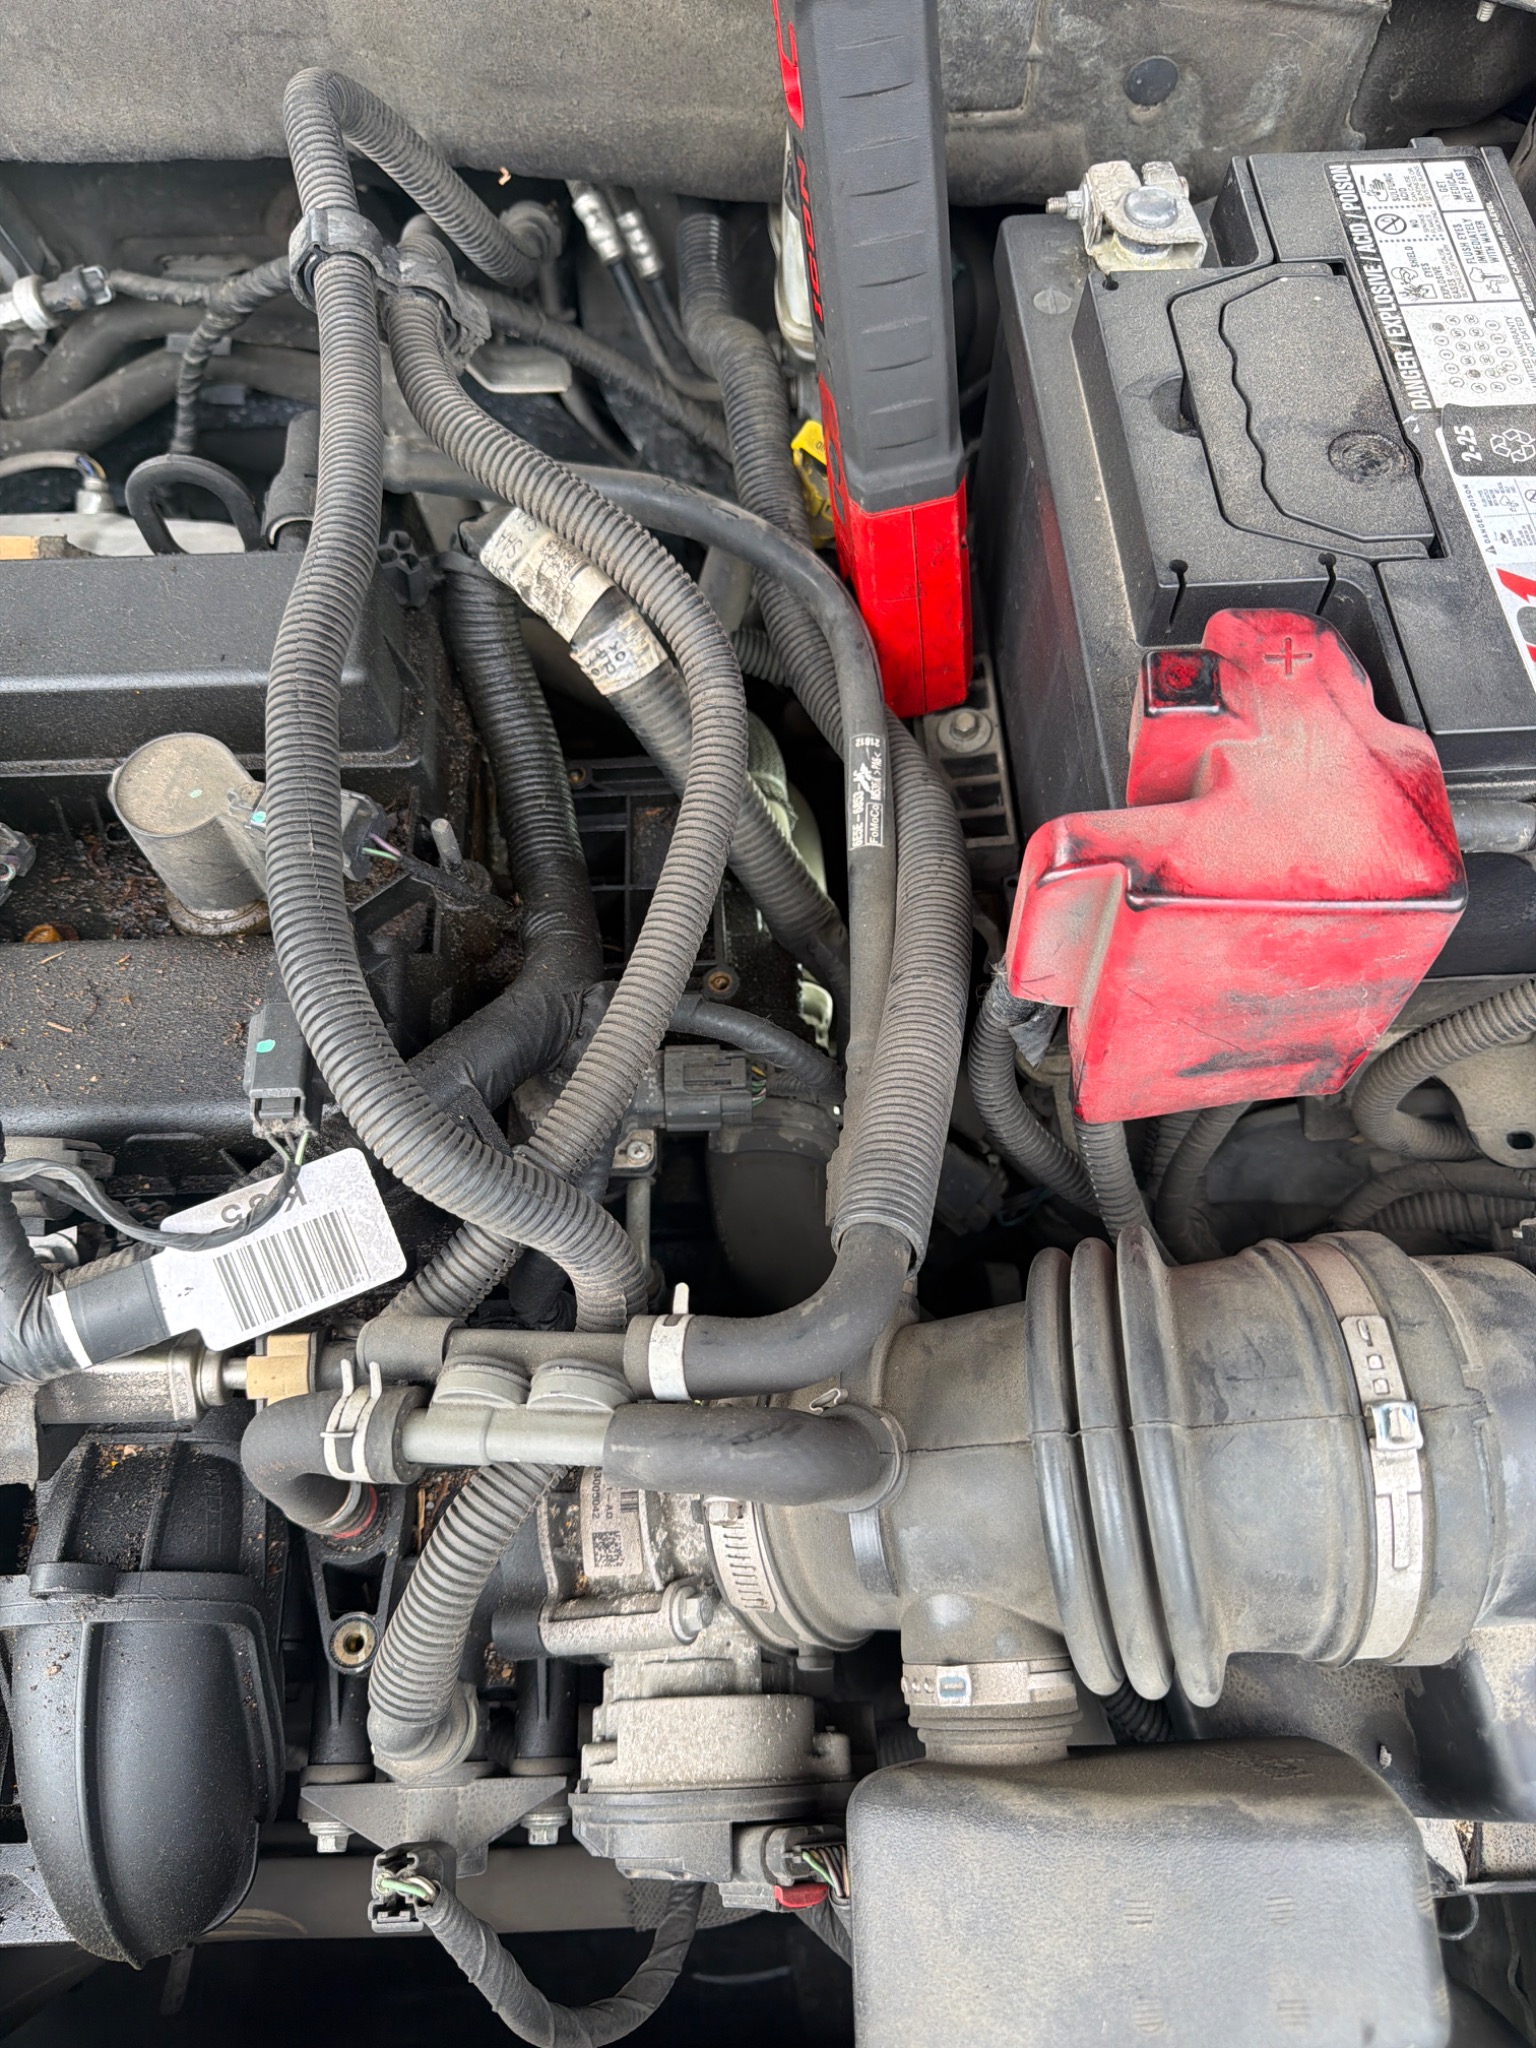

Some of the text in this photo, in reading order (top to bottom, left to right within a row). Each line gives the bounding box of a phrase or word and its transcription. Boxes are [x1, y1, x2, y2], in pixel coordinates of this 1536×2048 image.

[1328, 164, 1363, 211] POISON
[1383, 173, 1401, 202] SULFURIC
[1398, 187, 1411, 202] ACID
[1435, 179, 1449, 193] GET
[1443, 172, 1463, 201] MEDICAL
[1453, 168, 1476, 203] HELP FAST
[796, 155, 824, 323] ICON
[1348, 222, 1377, 253] ACID
[1409, 219, 1419, 229] NO
[1461, 217, 1489, 264] IMMEDIATELY
[1474, 219, 1500, 264] WITH WATER
[1404, 246, 1420, 268] SHIELD
[1452, 223, 1477, 264] FLUSH EYES
[1485, 200, 1535, 311] KEEP VENT CAPS TIGHT AND LEVEL
[1420, 262, 1434, 278] EYES
[1432, 265, 1452, 300] EXPLOSIVE
[1365, 264, 1407, 337] EXPLOSIVE
[1447, 278, 1462, 300] GASES
[1503, 315, 1527, 357] WARRANTY
[1514, 316, 1531, 340] DATED
[1525, 341, 1536, 357] NOT
[1395, 350, 1432, 410] DANGER
[1453, 424, 1483, 462] 2-25
[869, 804, 880, 843] FoMoCo
